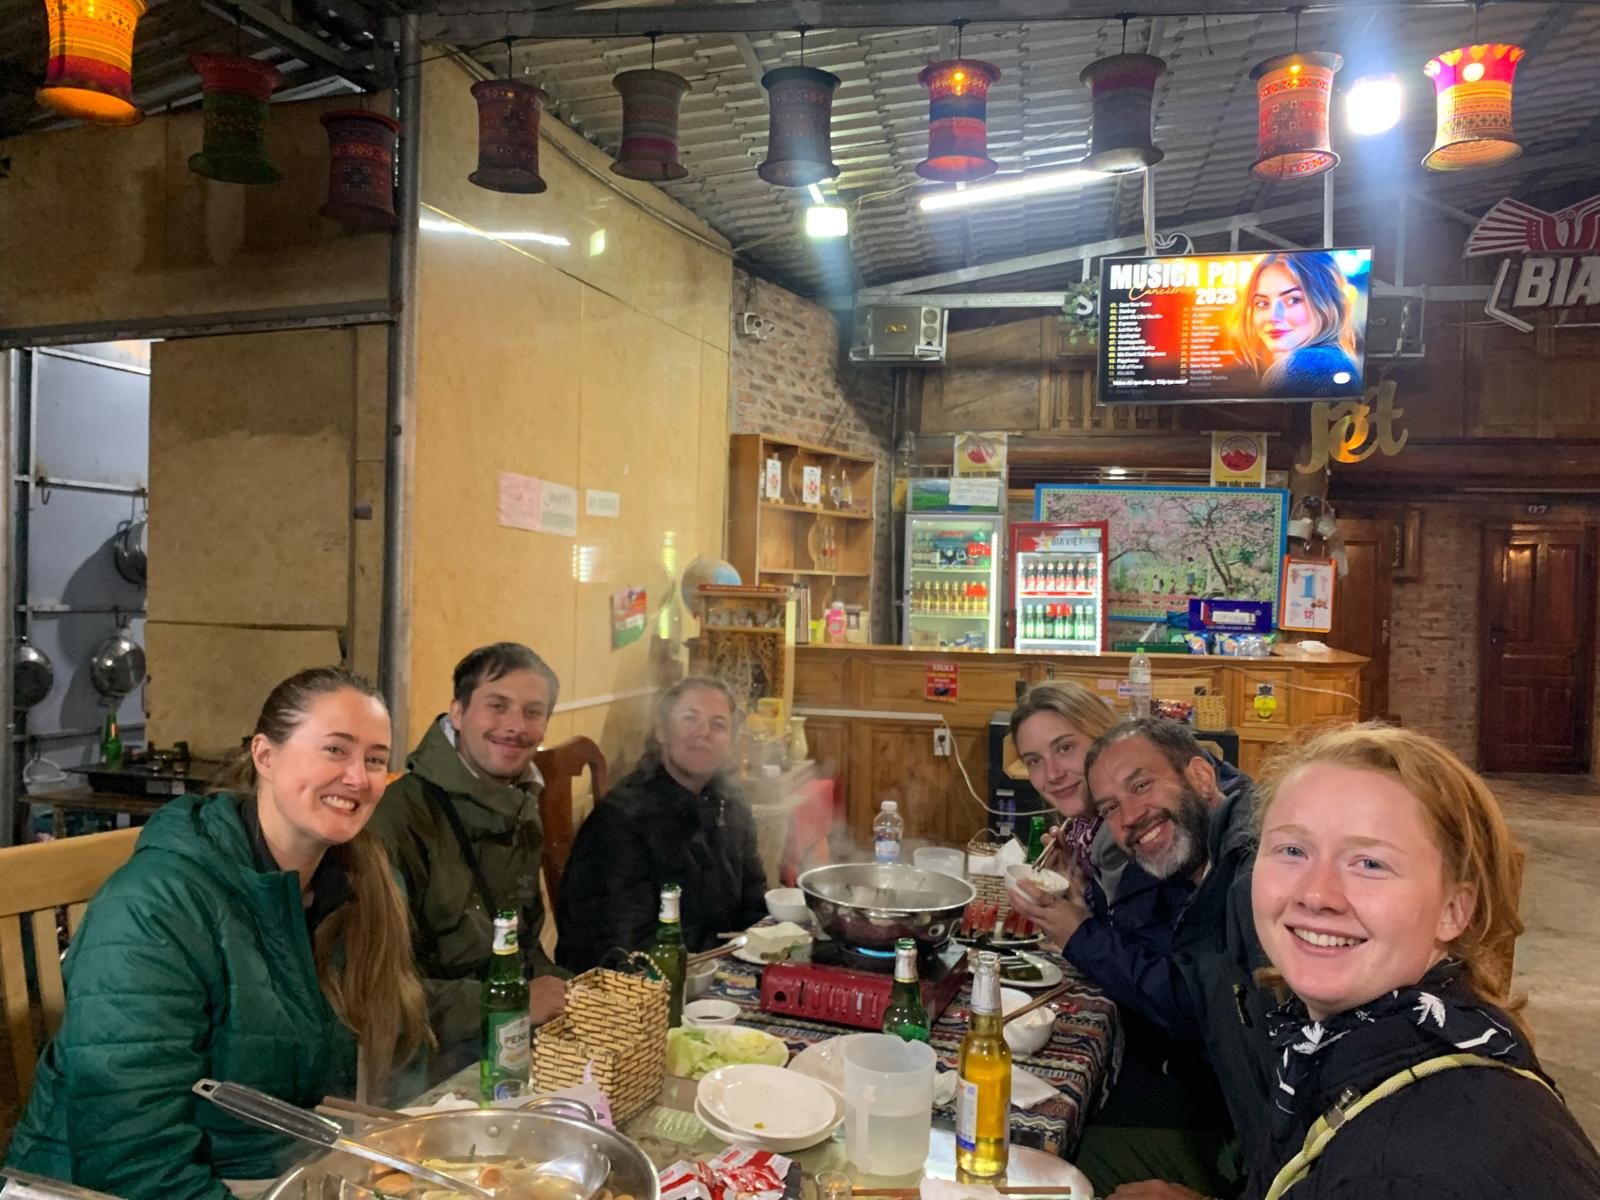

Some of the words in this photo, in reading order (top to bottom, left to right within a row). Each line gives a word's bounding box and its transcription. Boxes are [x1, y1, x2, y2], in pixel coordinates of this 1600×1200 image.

[1110, 263, 1199, 290] MUSICA
[1512, 256, 1600, 307] BIA
[1195, 287, 1237, 305] 2025
[1527, 504, 1548, 514] 07
